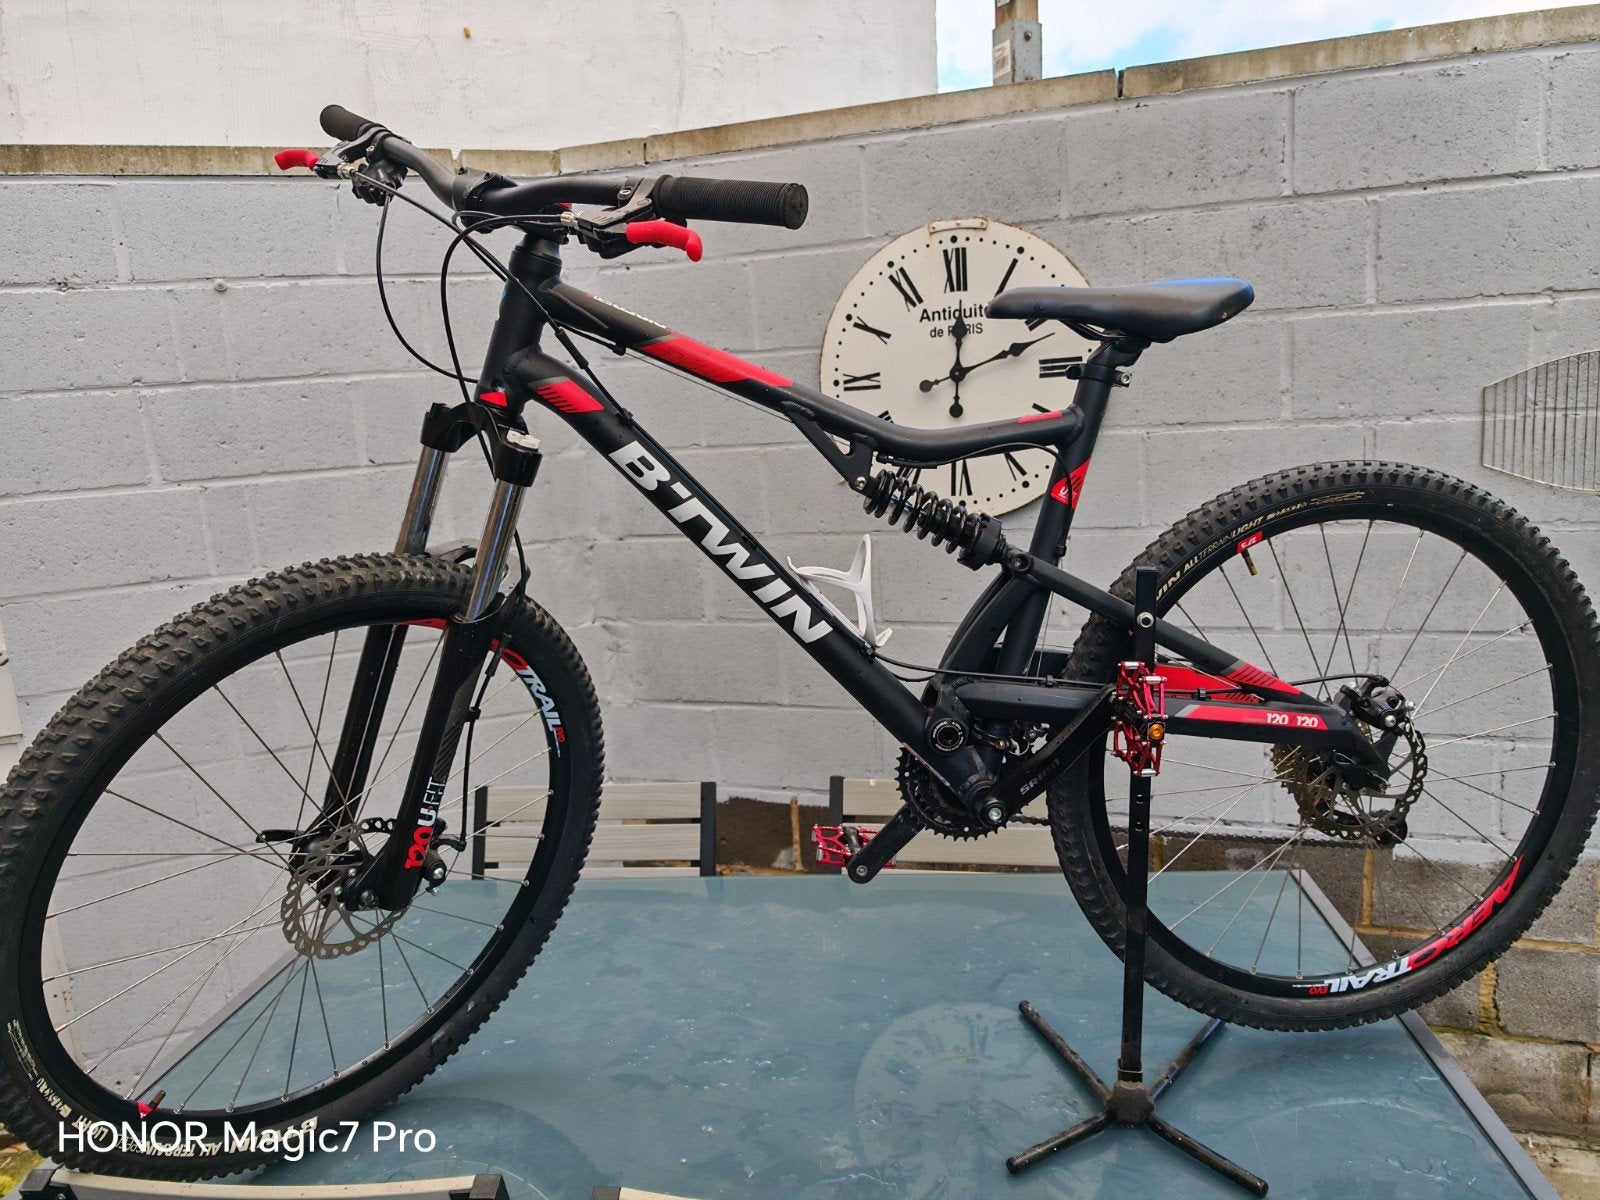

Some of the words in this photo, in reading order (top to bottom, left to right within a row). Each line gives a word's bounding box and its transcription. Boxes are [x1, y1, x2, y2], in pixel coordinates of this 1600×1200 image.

[943, 247, 968, 293] XII
[888, 266, 924, 312] XI
[919, 304, 986, 323] Antiquit
[853, 316, 892, 345] X
[930, 327, 943, 338] de
[948, 322, 983, 336] PRIS
[843, 372, 881, 391] IX
[1309, 985, 1328, 996] EVO
